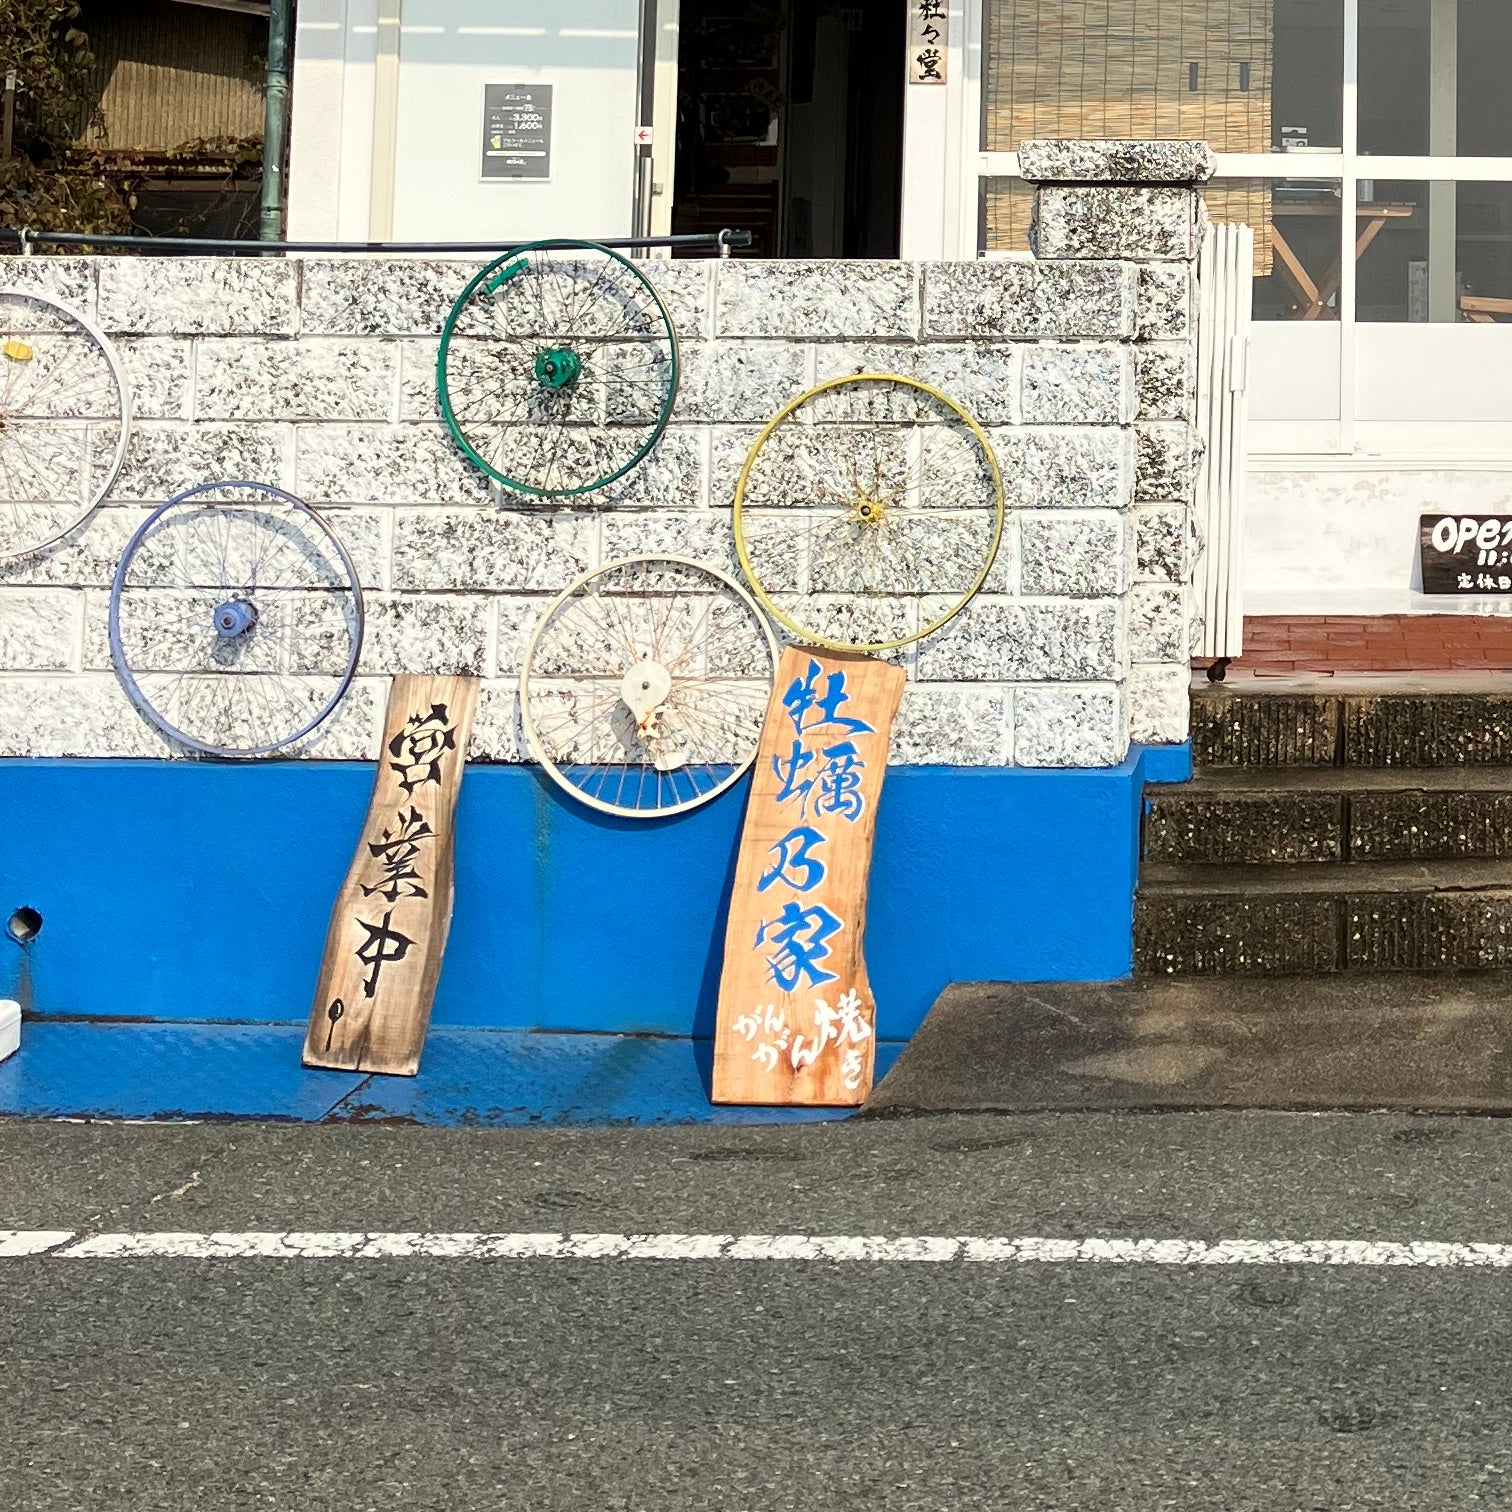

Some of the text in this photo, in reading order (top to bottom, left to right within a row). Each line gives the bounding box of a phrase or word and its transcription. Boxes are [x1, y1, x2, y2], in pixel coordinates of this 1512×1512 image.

[356, 703, 456, 1000] 営業中
[753, 657, 878, 992] 牡蠣乃家
